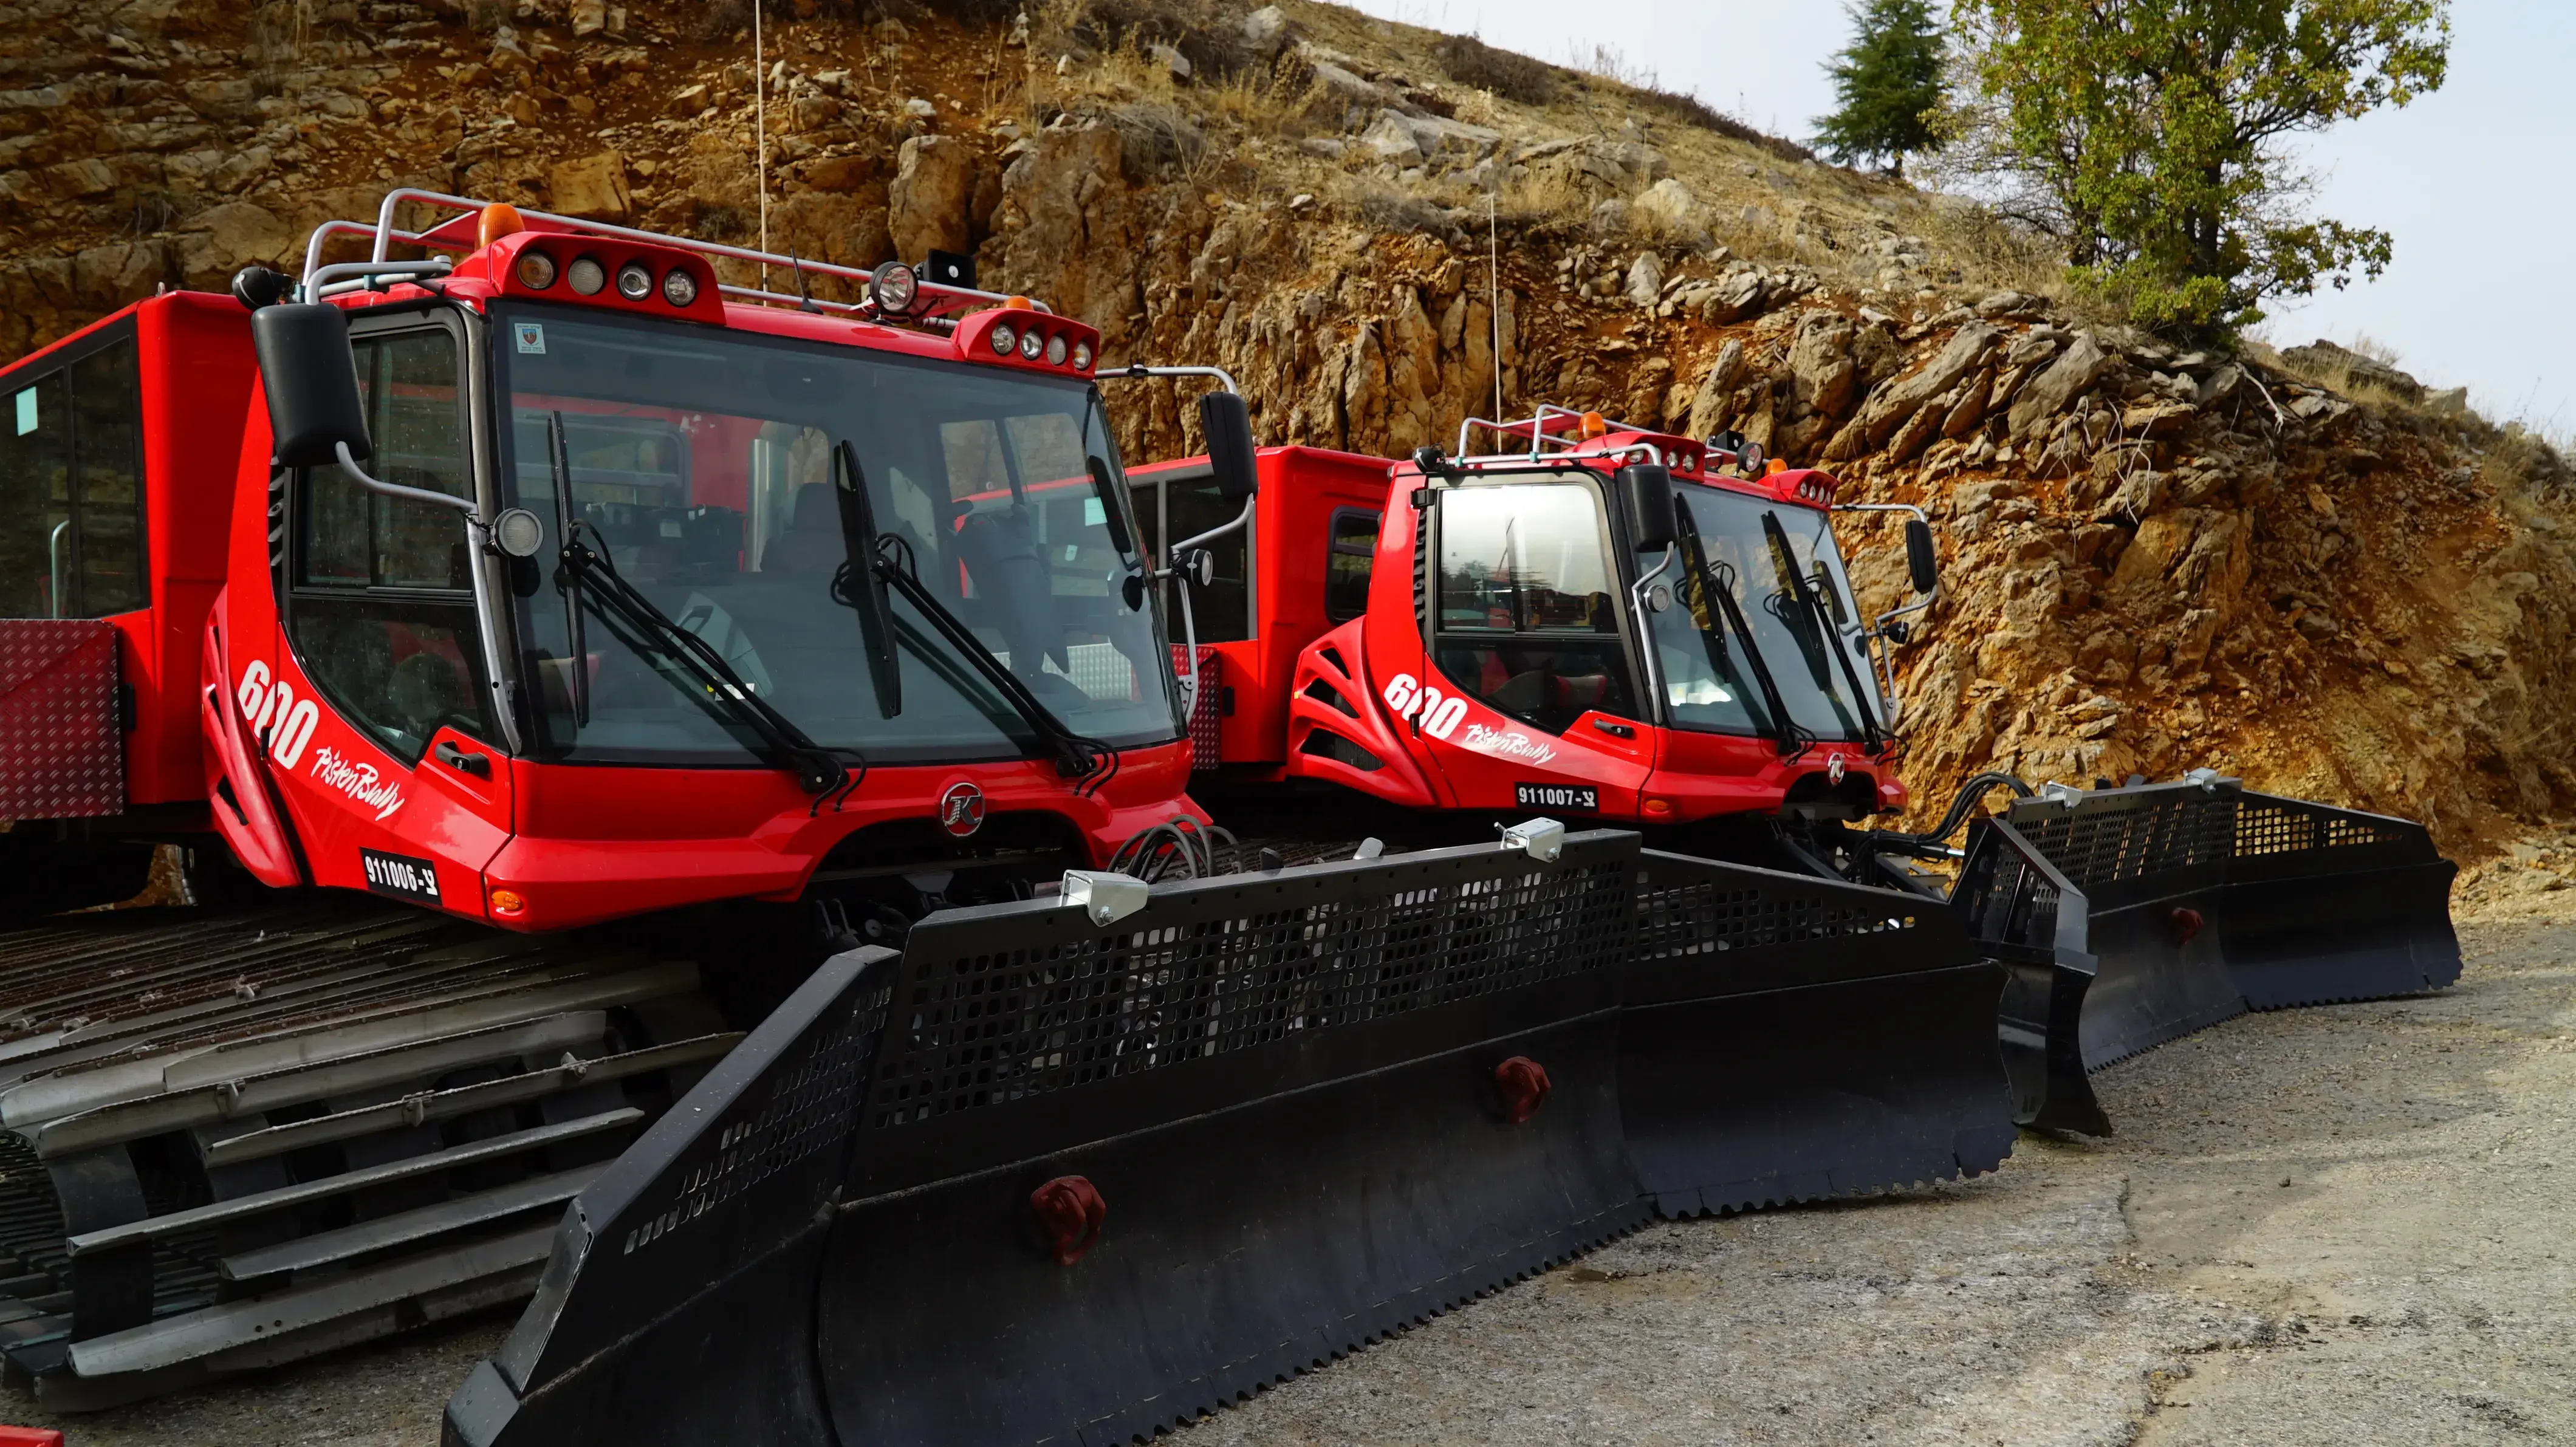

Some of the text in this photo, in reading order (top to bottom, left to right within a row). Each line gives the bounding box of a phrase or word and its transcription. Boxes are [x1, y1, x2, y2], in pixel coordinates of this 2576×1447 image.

[238, 660, 319, 770] 600
[1384, 674, 1468, 740] 600
[1465, 724, 1557, 765] PistenBully
[311, 747, 405, 821] PistenBully
